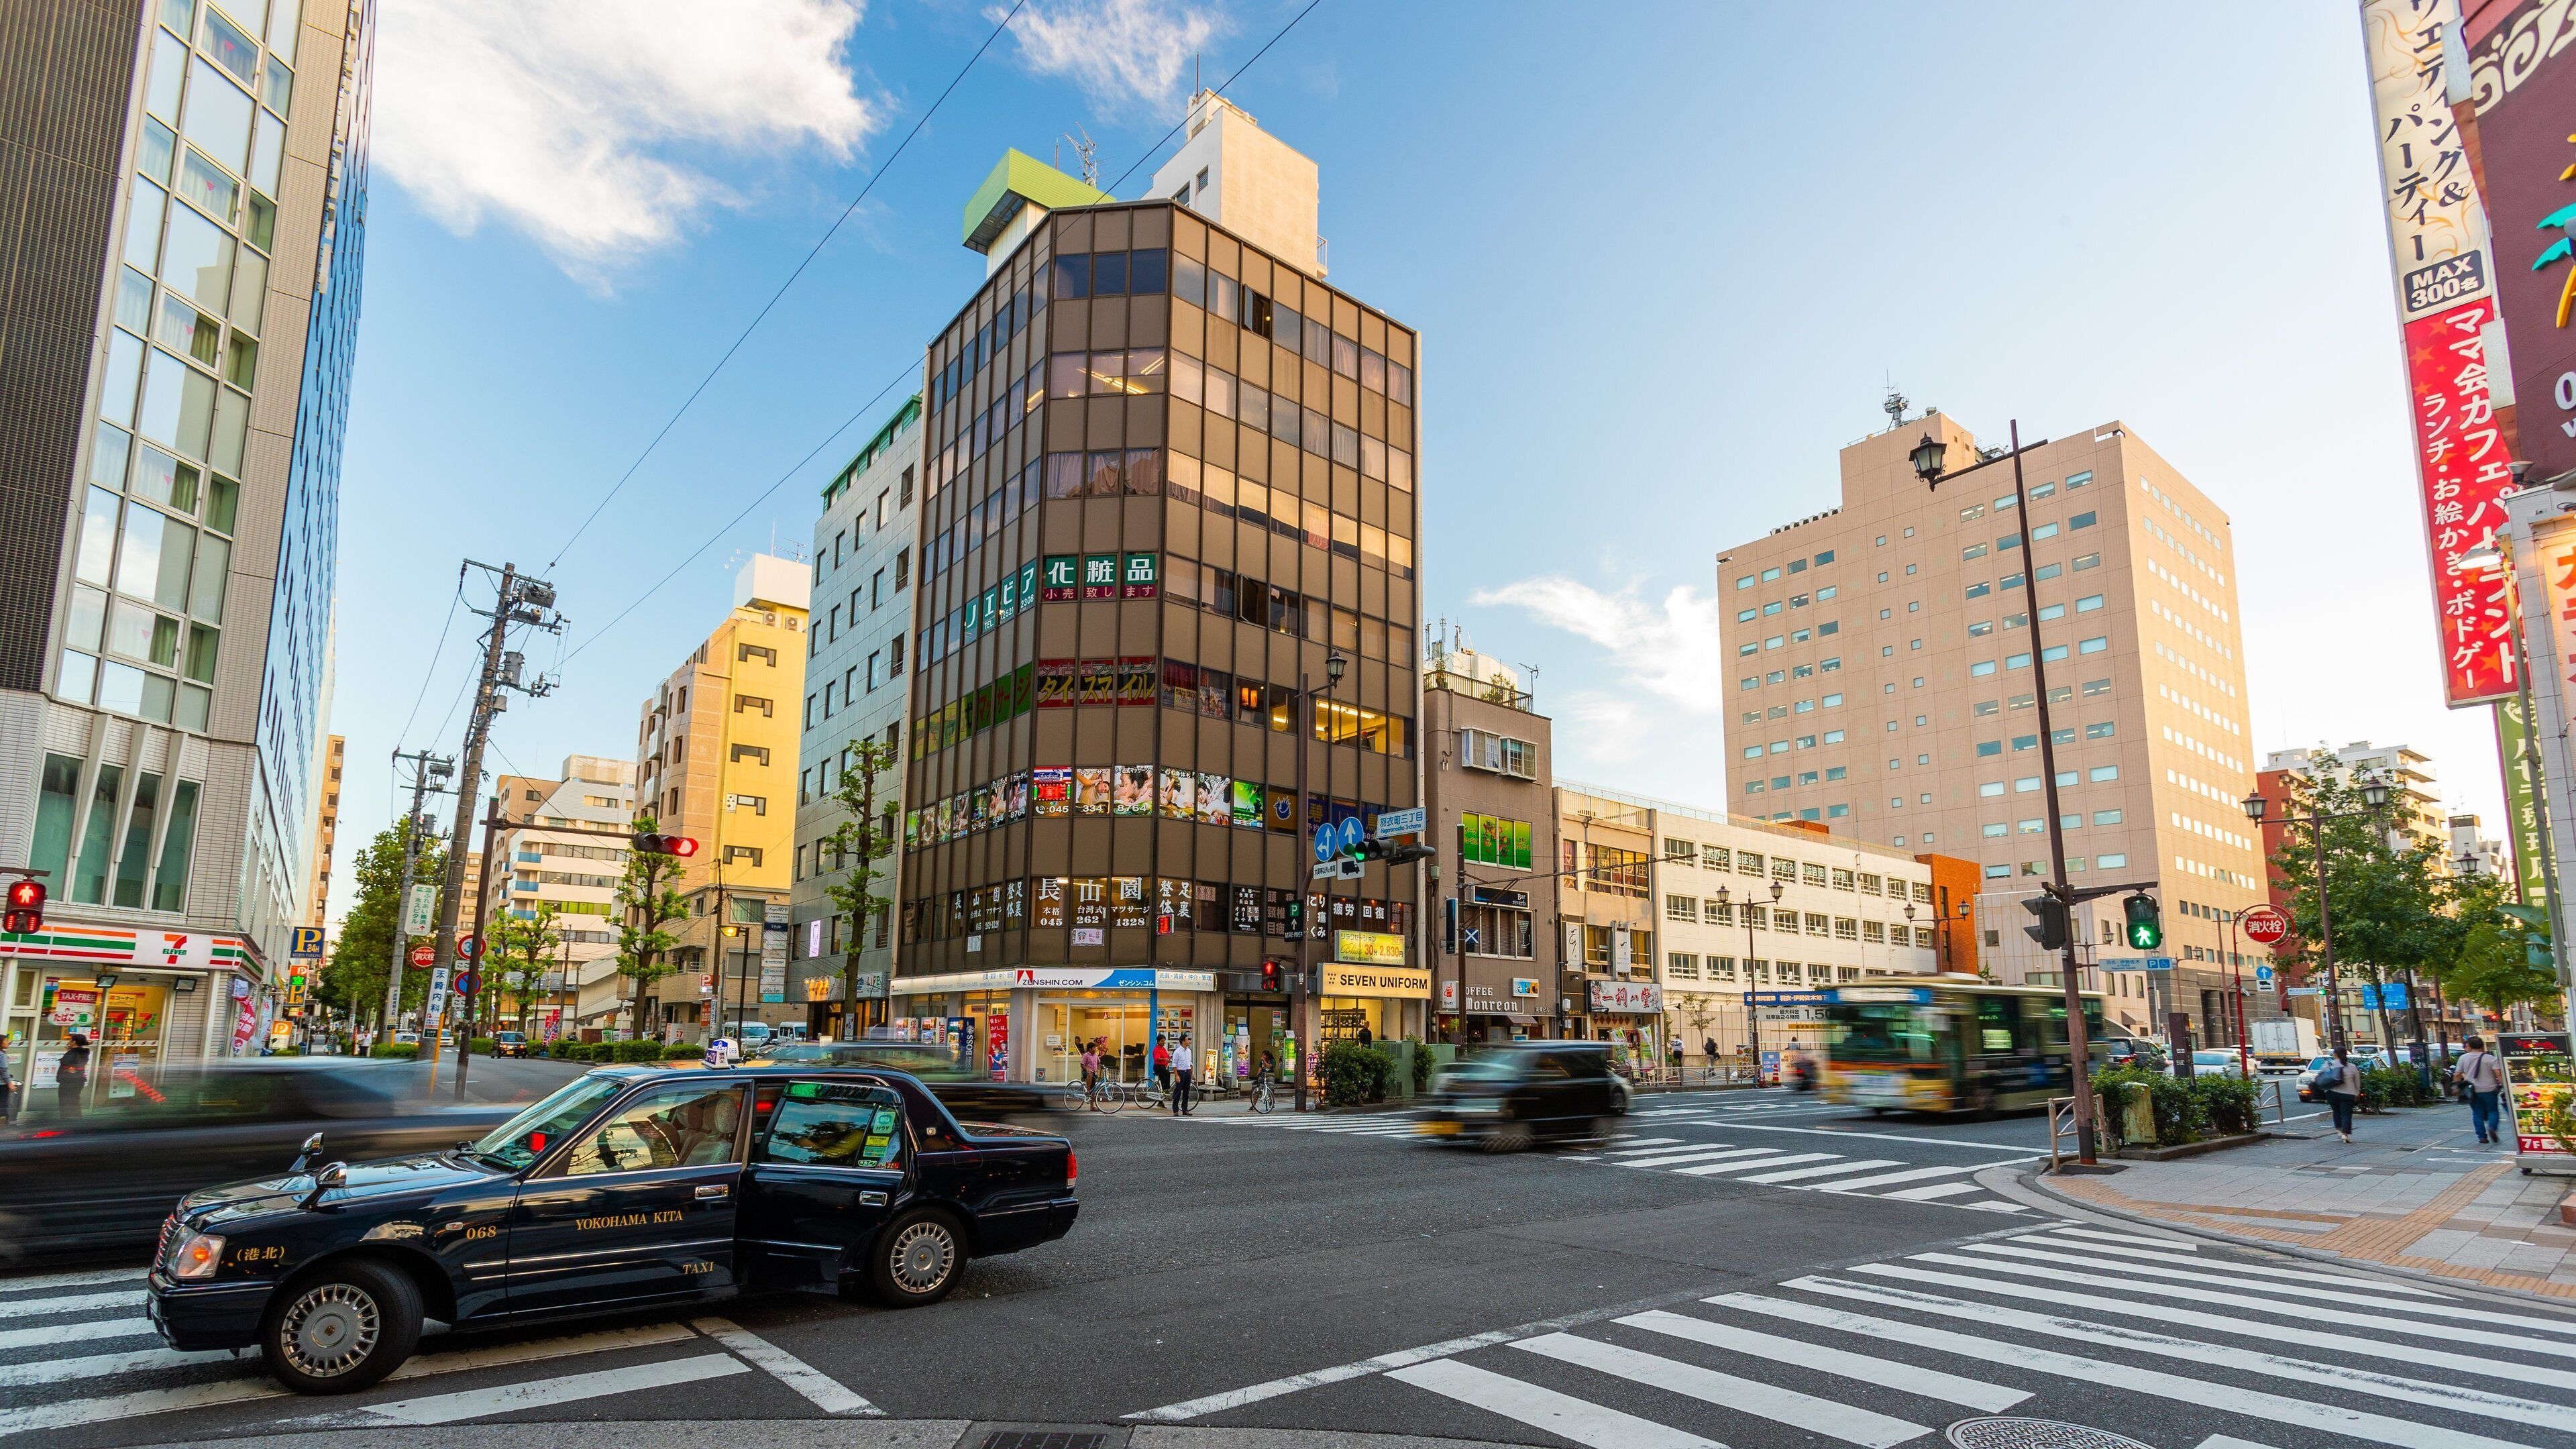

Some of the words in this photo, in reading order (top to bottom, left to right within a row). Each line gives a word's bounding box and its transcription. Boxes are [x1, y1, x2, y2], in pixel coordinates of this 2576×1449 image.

[2385, 103, 2428, 261] パーティー
[2412, 256, 2473, 290] MAX
[2411, 278, 2479, 309] 300名
[1049, 557, 1153, 584] 化粧品
[967, 567, 1034, 629] ノエビア
[1046, 586, 1153, 600] 小売致します
[1020, 594, 1034, 608] 2308
[1380, 811, 1423, 827] 羽衣町三丁目
[1381, 825, 1405, 834] Hagoromocho
[1038, 877, 1142, 903] 長山園
[1159, 879, 1174, 915] 整体
[1177, 881, 1192, 918] 足裏
[1042, 906, 1060, 915] 本格
[1077, 906, 1104, 914] 台湾式
[1291, 904, 1297, 915] P
[1334, 902, 1384, 920] 疲労回復
[1040, 918, 1063, 926] 045
[1076, 916, 1099, 924] 262
[1116, 917, 1144, 926] 1328
[2247, 920, 2282, 933] 消火栓
[294, 928, 322, 953] P
[1392, 936, 1403, 945] 2F
[415, 953, 435, 961] 消火栓
[1340, 975, 1376, 987] SEVEN
[1380, 975, 1428, 989] UNIFORM
[61, 992, 96, 1002] TAX-FREE
[1465, 987, 1493, 996] OFFEE
[1465, 997, 1518, 1012] Monreon
[54, 1013, 75, 1023] たばこ
[2521, 1138, 2540, 1149] 7F
[575, 1214, 647, 1230] YOKOHAMA
[653, 1210, 684, 1224] KITA
[466, 1226, 496, 1240] 068
[237, 1246, 285, 1261] (港北)
[682, 1261, 714, 1275] TAXI
